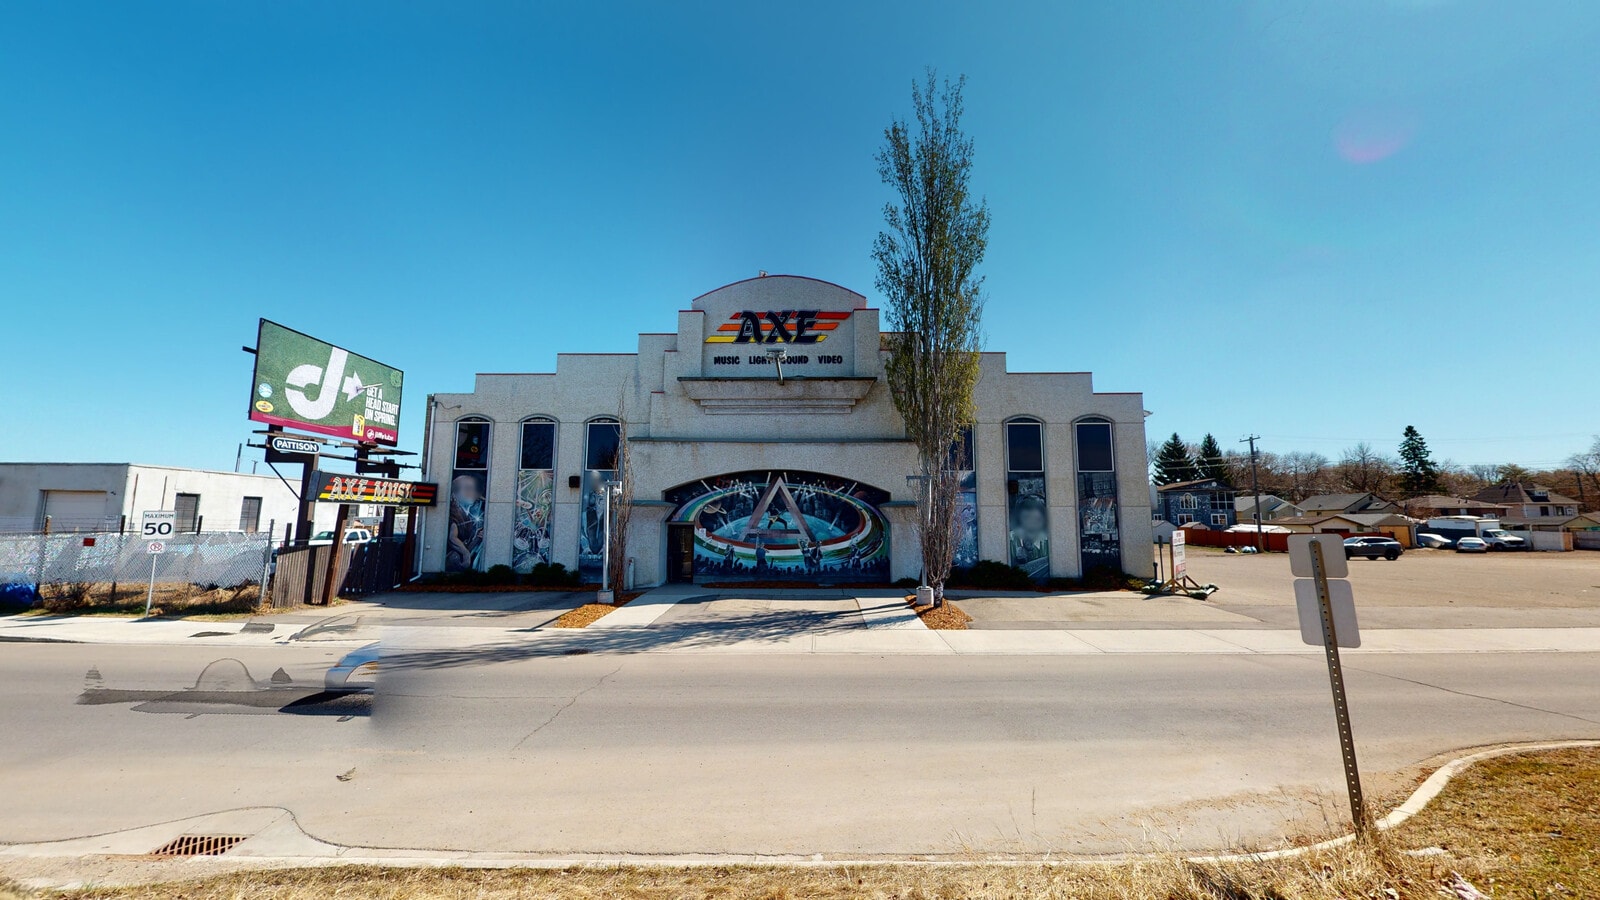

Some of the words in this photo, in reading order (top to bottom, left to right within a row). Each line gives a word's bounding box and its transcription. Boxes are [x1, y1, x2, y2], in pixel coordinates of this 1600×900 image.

[734, 309, 820, 345] AXE
[713, 356, 740, 365] MUSIC
[818, 355, 843, 364] VIDEO
[378, 388, 383, 399] A
[365, 397, 382, 411] HEAD
[382, 401, 399, 415] START
[364, 408, 374, 420] ON
[276, 439, 318, 453] PATTISON
[328, 476, 368, 501] AXE
[372, 480, 417, 503] MUSIC
[144, 522, 172, 535] 50
